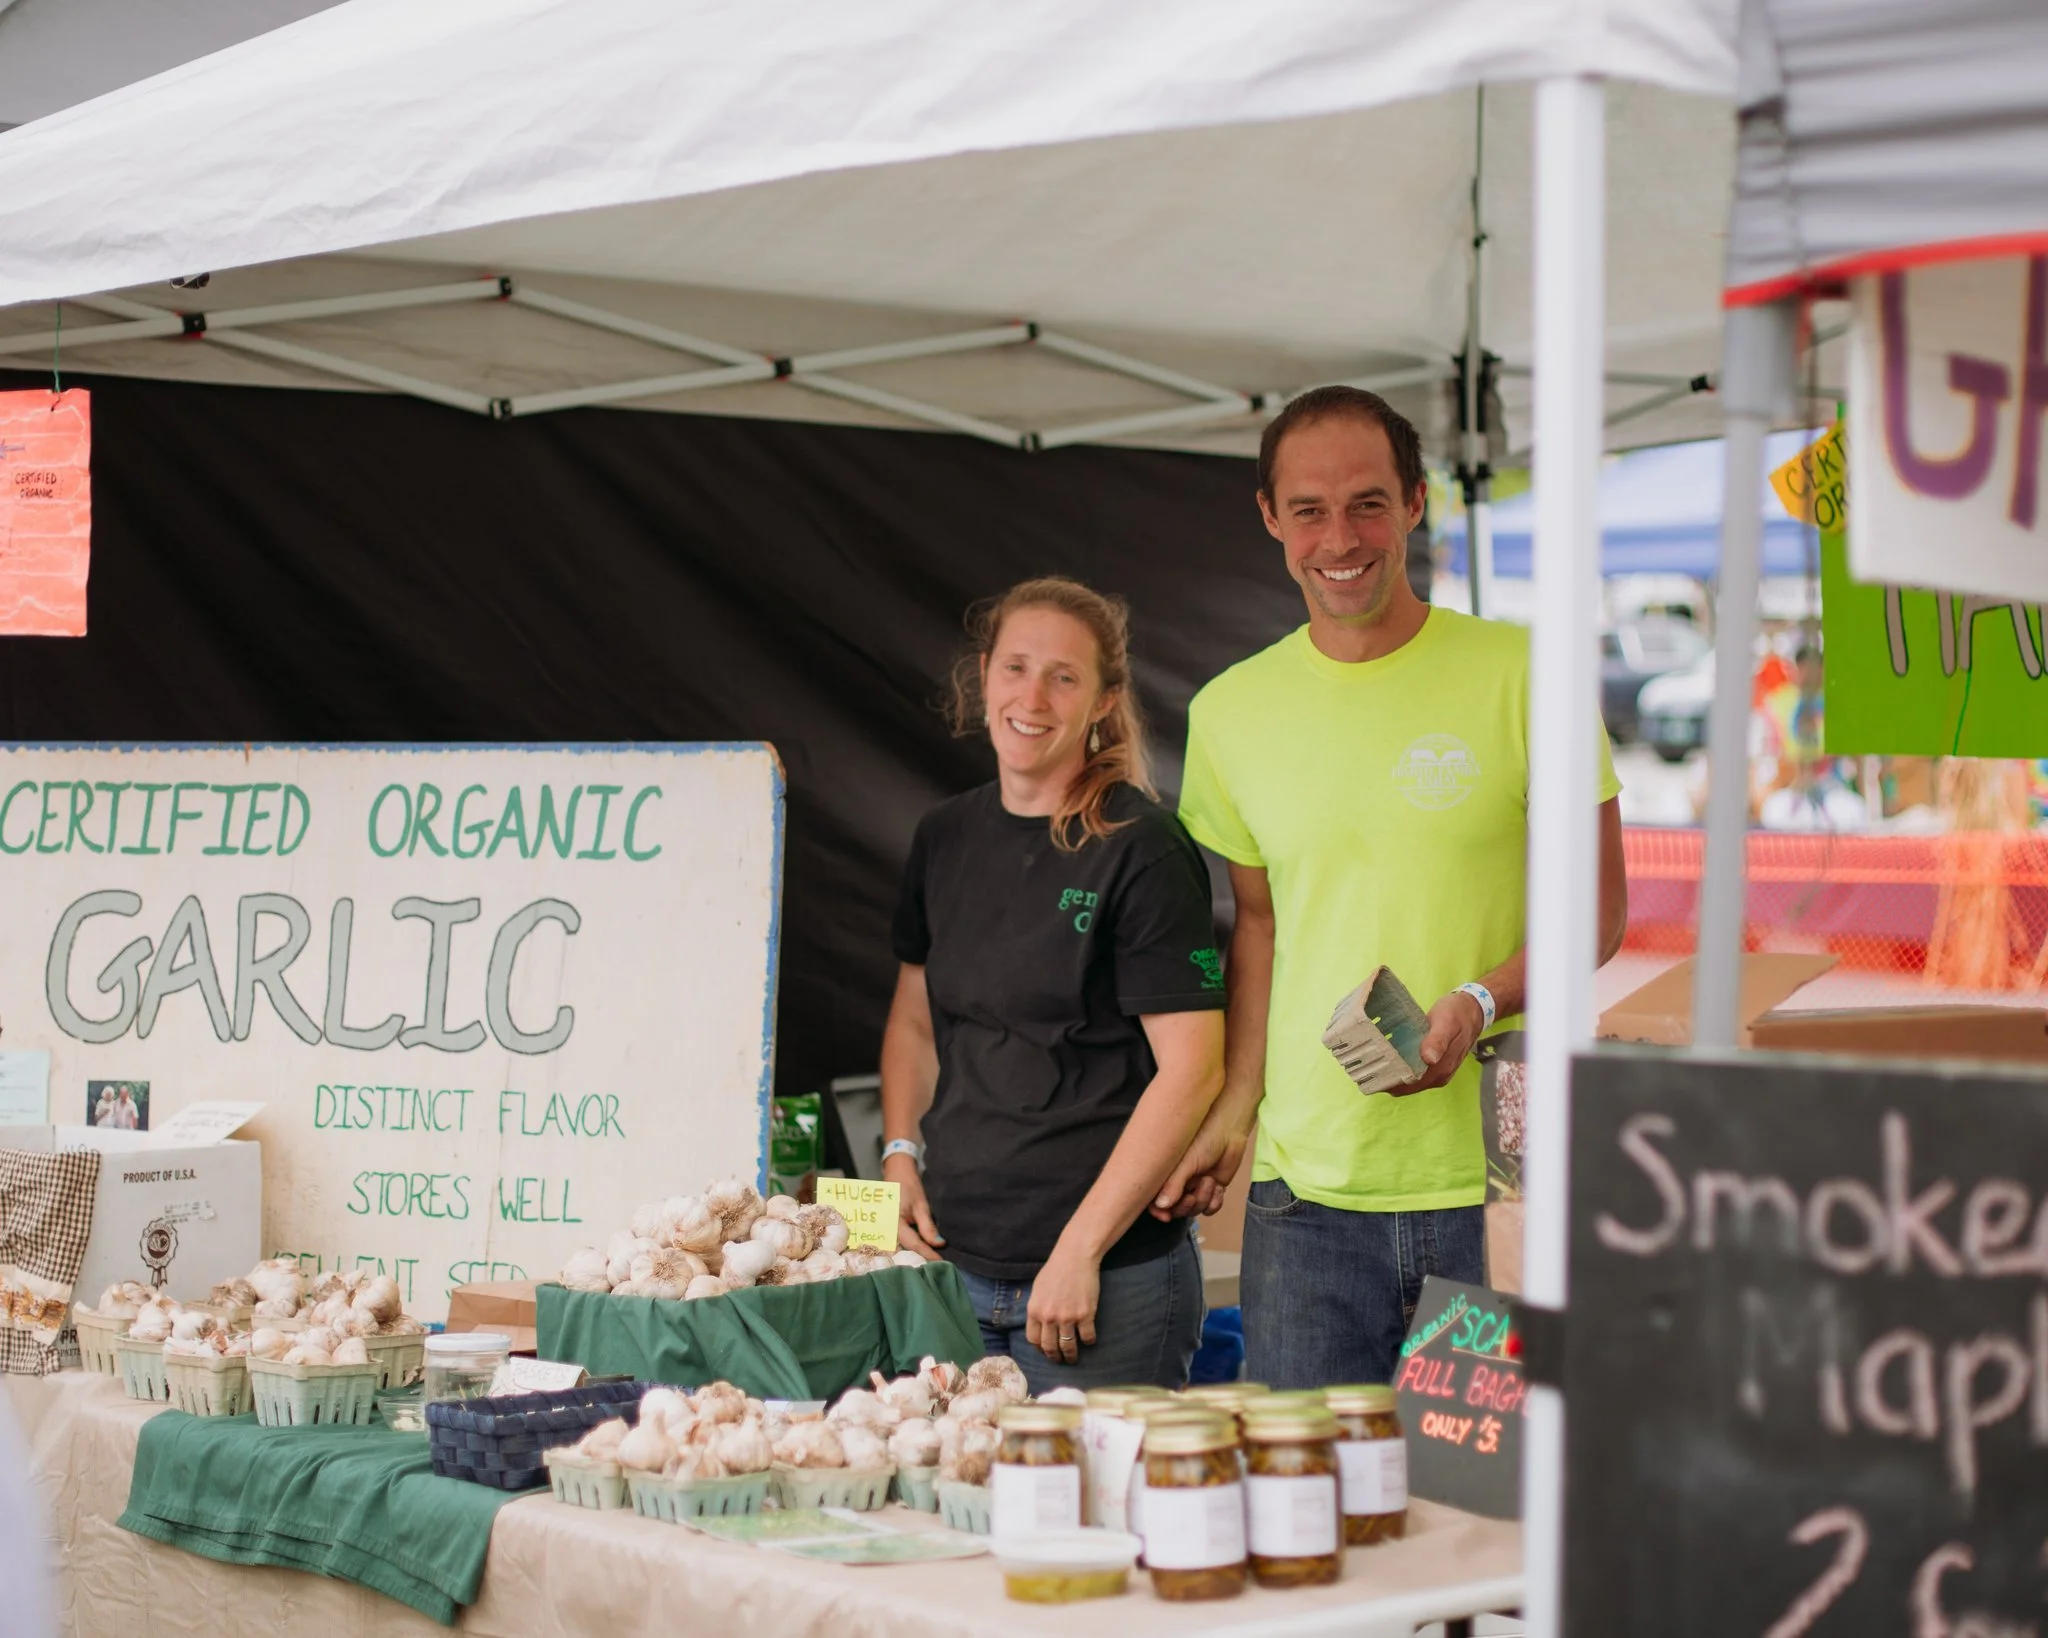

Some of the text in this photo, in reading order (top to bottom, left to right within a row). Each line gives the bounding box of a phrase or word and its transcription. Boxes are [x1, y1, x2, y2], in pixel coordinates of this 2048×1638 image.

[15, 472, 57, 485] CERTIFIED
[0, 780, 663, 861] CERTIFIED ORGANIC
[46, 890, 581, 1054] GARLIC
[314, 1084, 625, 1138] DISTINCT FLAVOR
[123, 1168, 197, 1184] PRODUCT OF U.S.A.
[347, 1171, 583, 1223] STORES WELL
[834, 1183, 884, 1203] HUGE
[1594, 1108, 2048, 1279] Smoke
[1398, 1356, 1455, 1398] FULL
[1422, 1411, 1473, 1444] ONLY
